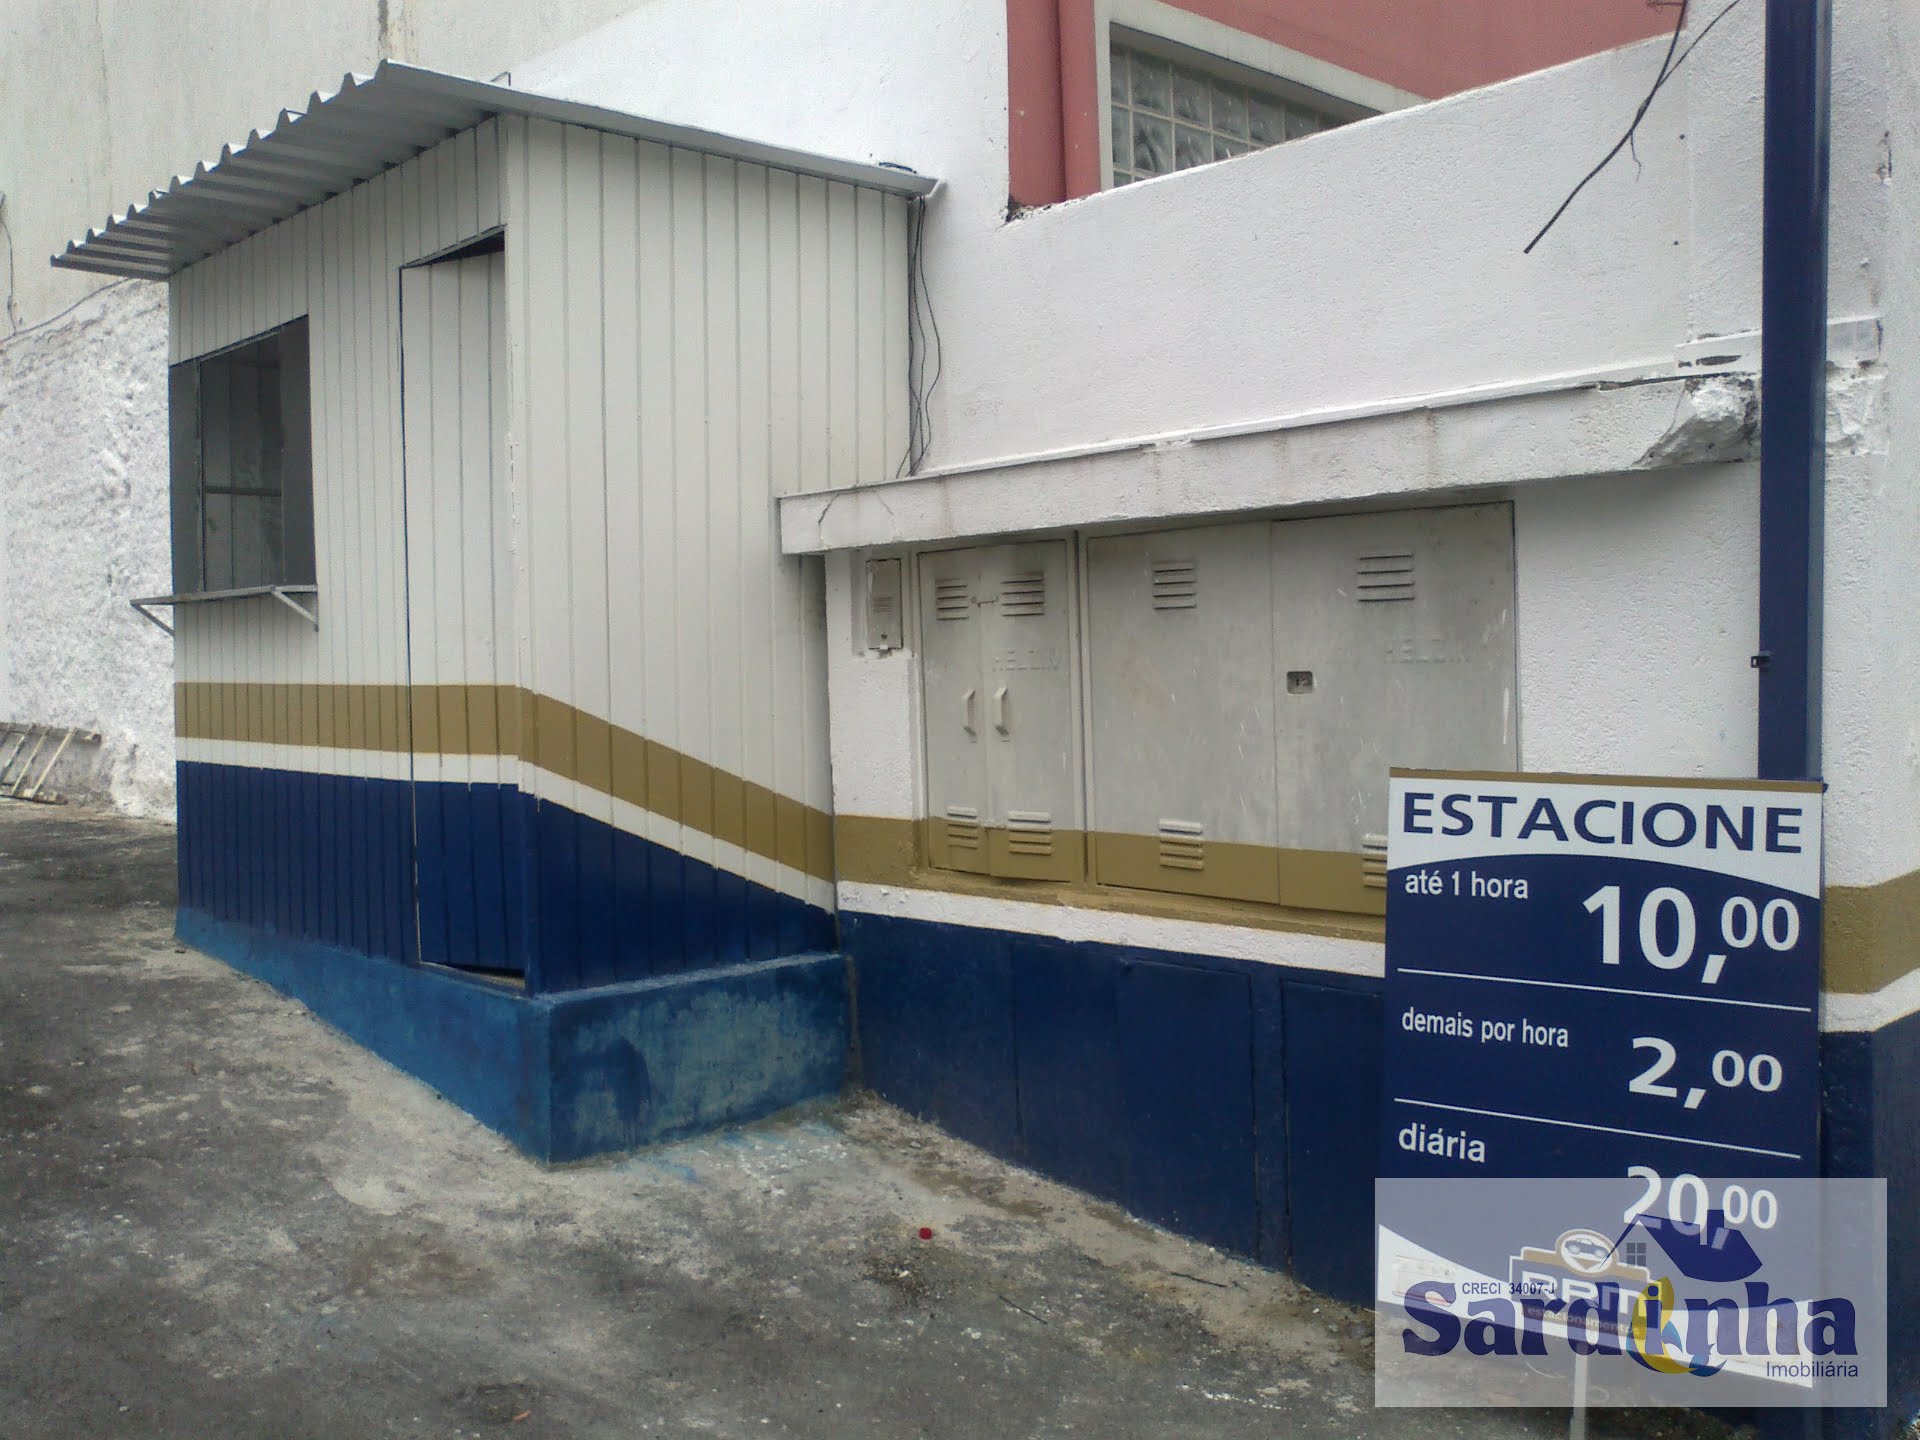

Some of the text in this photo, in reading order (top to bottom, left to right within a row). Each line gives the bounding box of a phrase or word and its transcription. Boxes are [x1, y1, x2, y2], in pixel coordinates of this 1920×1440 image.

[1403, 792, 1802, 854] ESTACIONE
[1404, 869, 1800, 984] até 1 hora 10,00
[1402, 1007, 1783, 1109] demais por hora 2,00
[1398, 1123, 1486, 1163] diária
